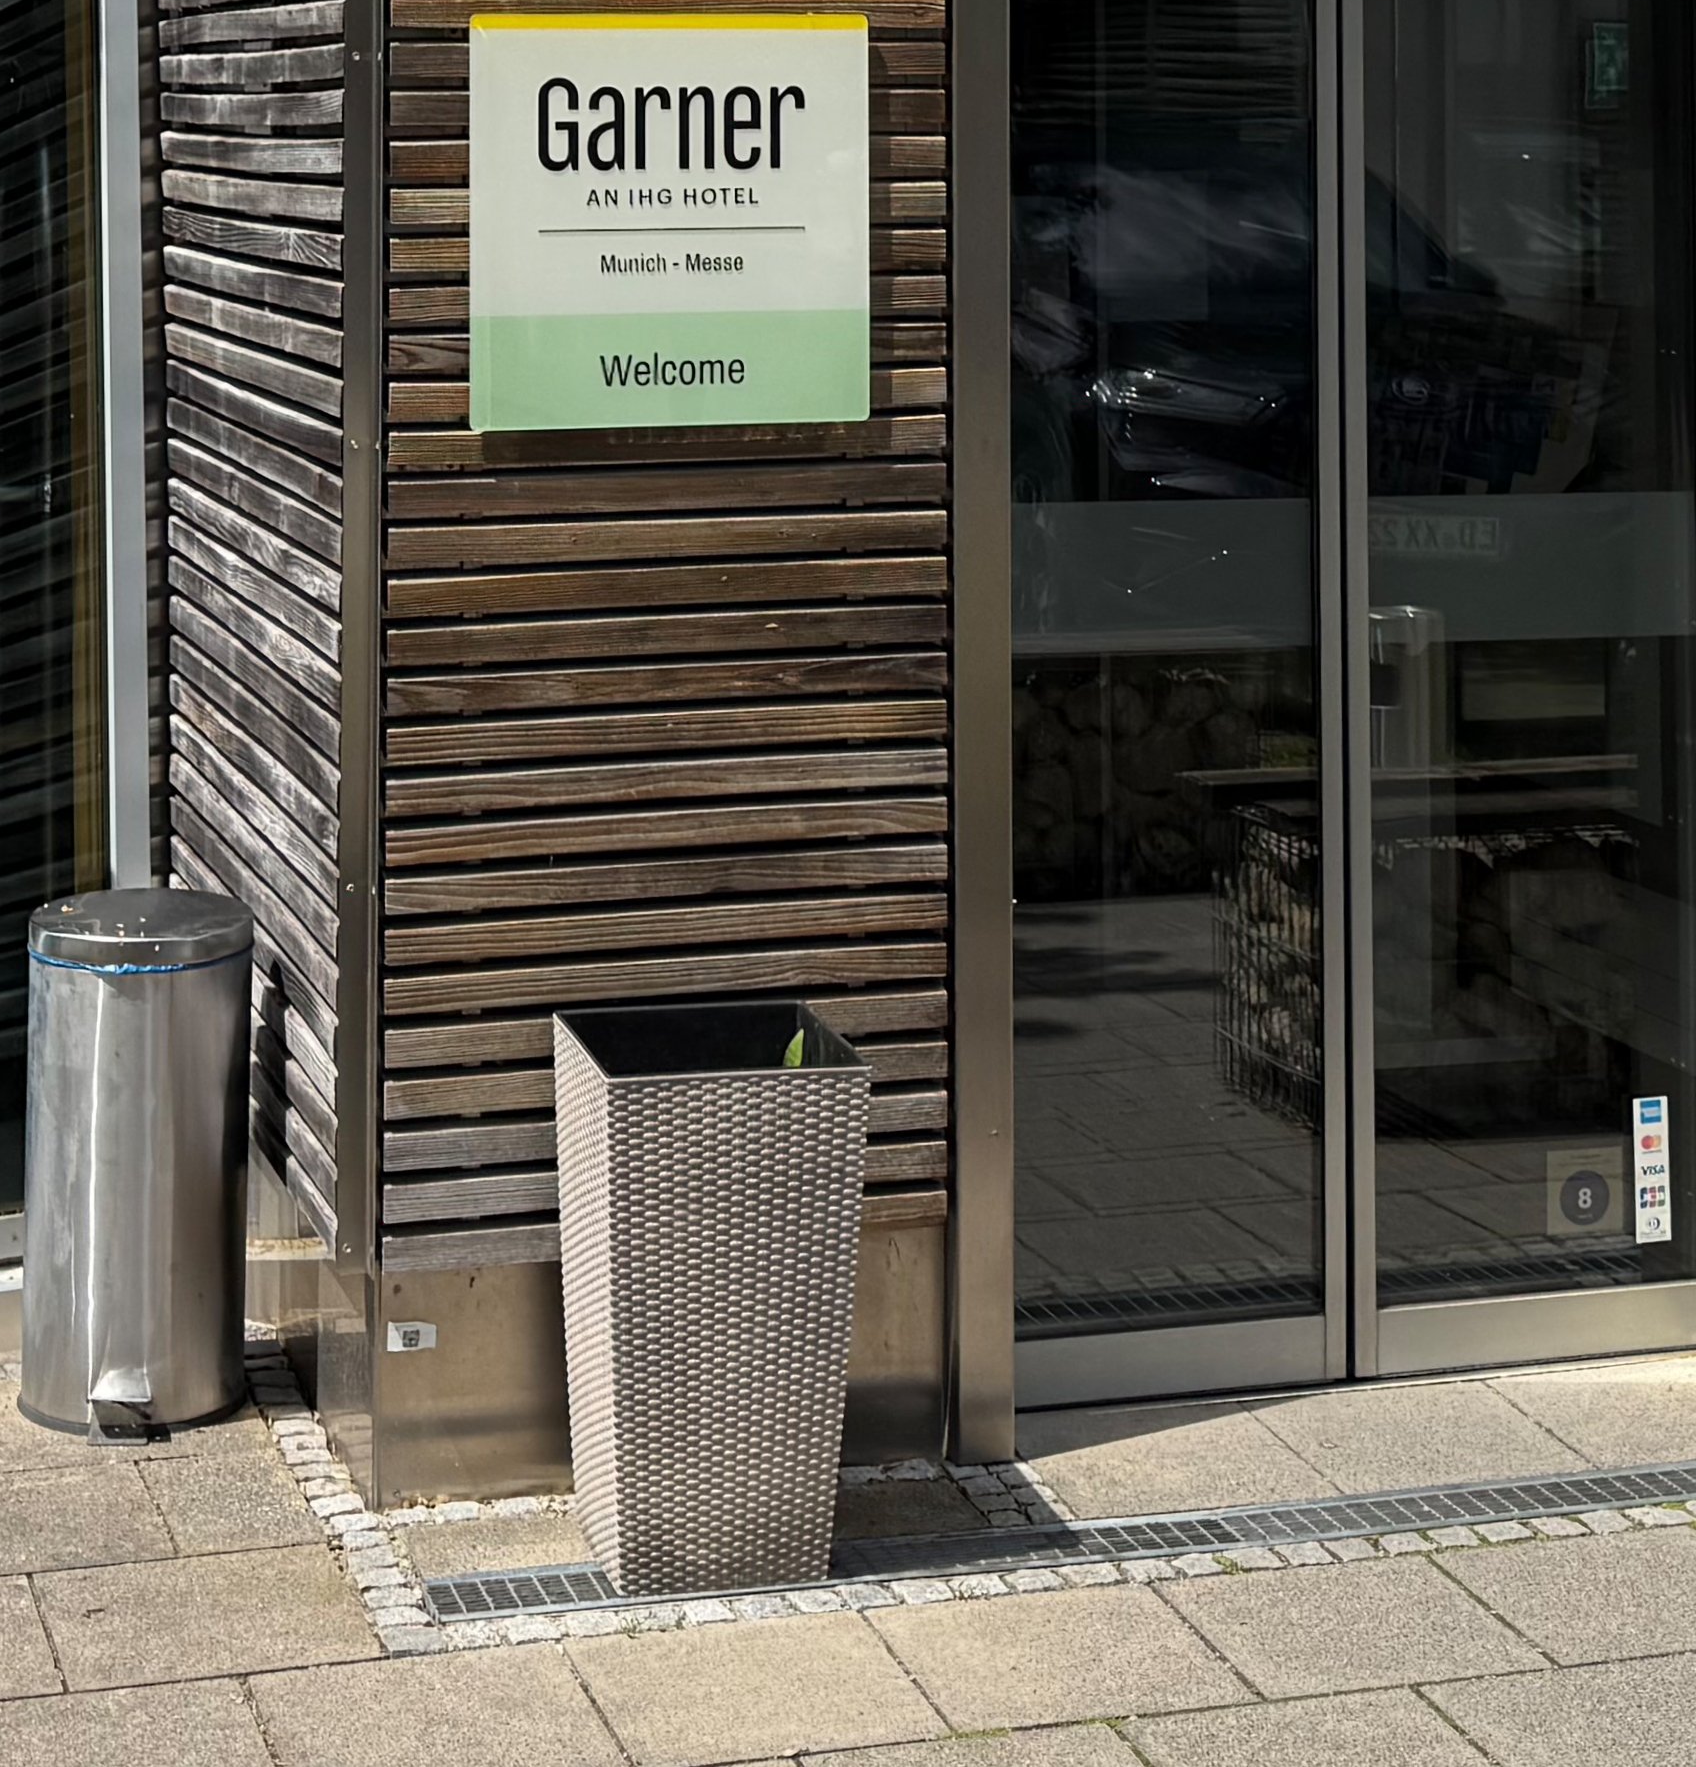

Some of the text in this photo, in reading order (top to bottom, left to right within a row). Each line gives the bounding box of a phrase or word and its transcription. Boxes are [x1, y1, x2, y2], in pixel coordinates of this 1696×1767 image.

[537, 77, 806, 172] Garner
[586, 187, 759, 207] AN IHG HOTEL
[600, 252, 667, 274] Munich
[685, 253, 744, 272] Messe
[599, 352, 745, 387] Welcome
[1640, 1164, 1666, 1176] VISA
[1578, 1188, 1592, 1209] 8
